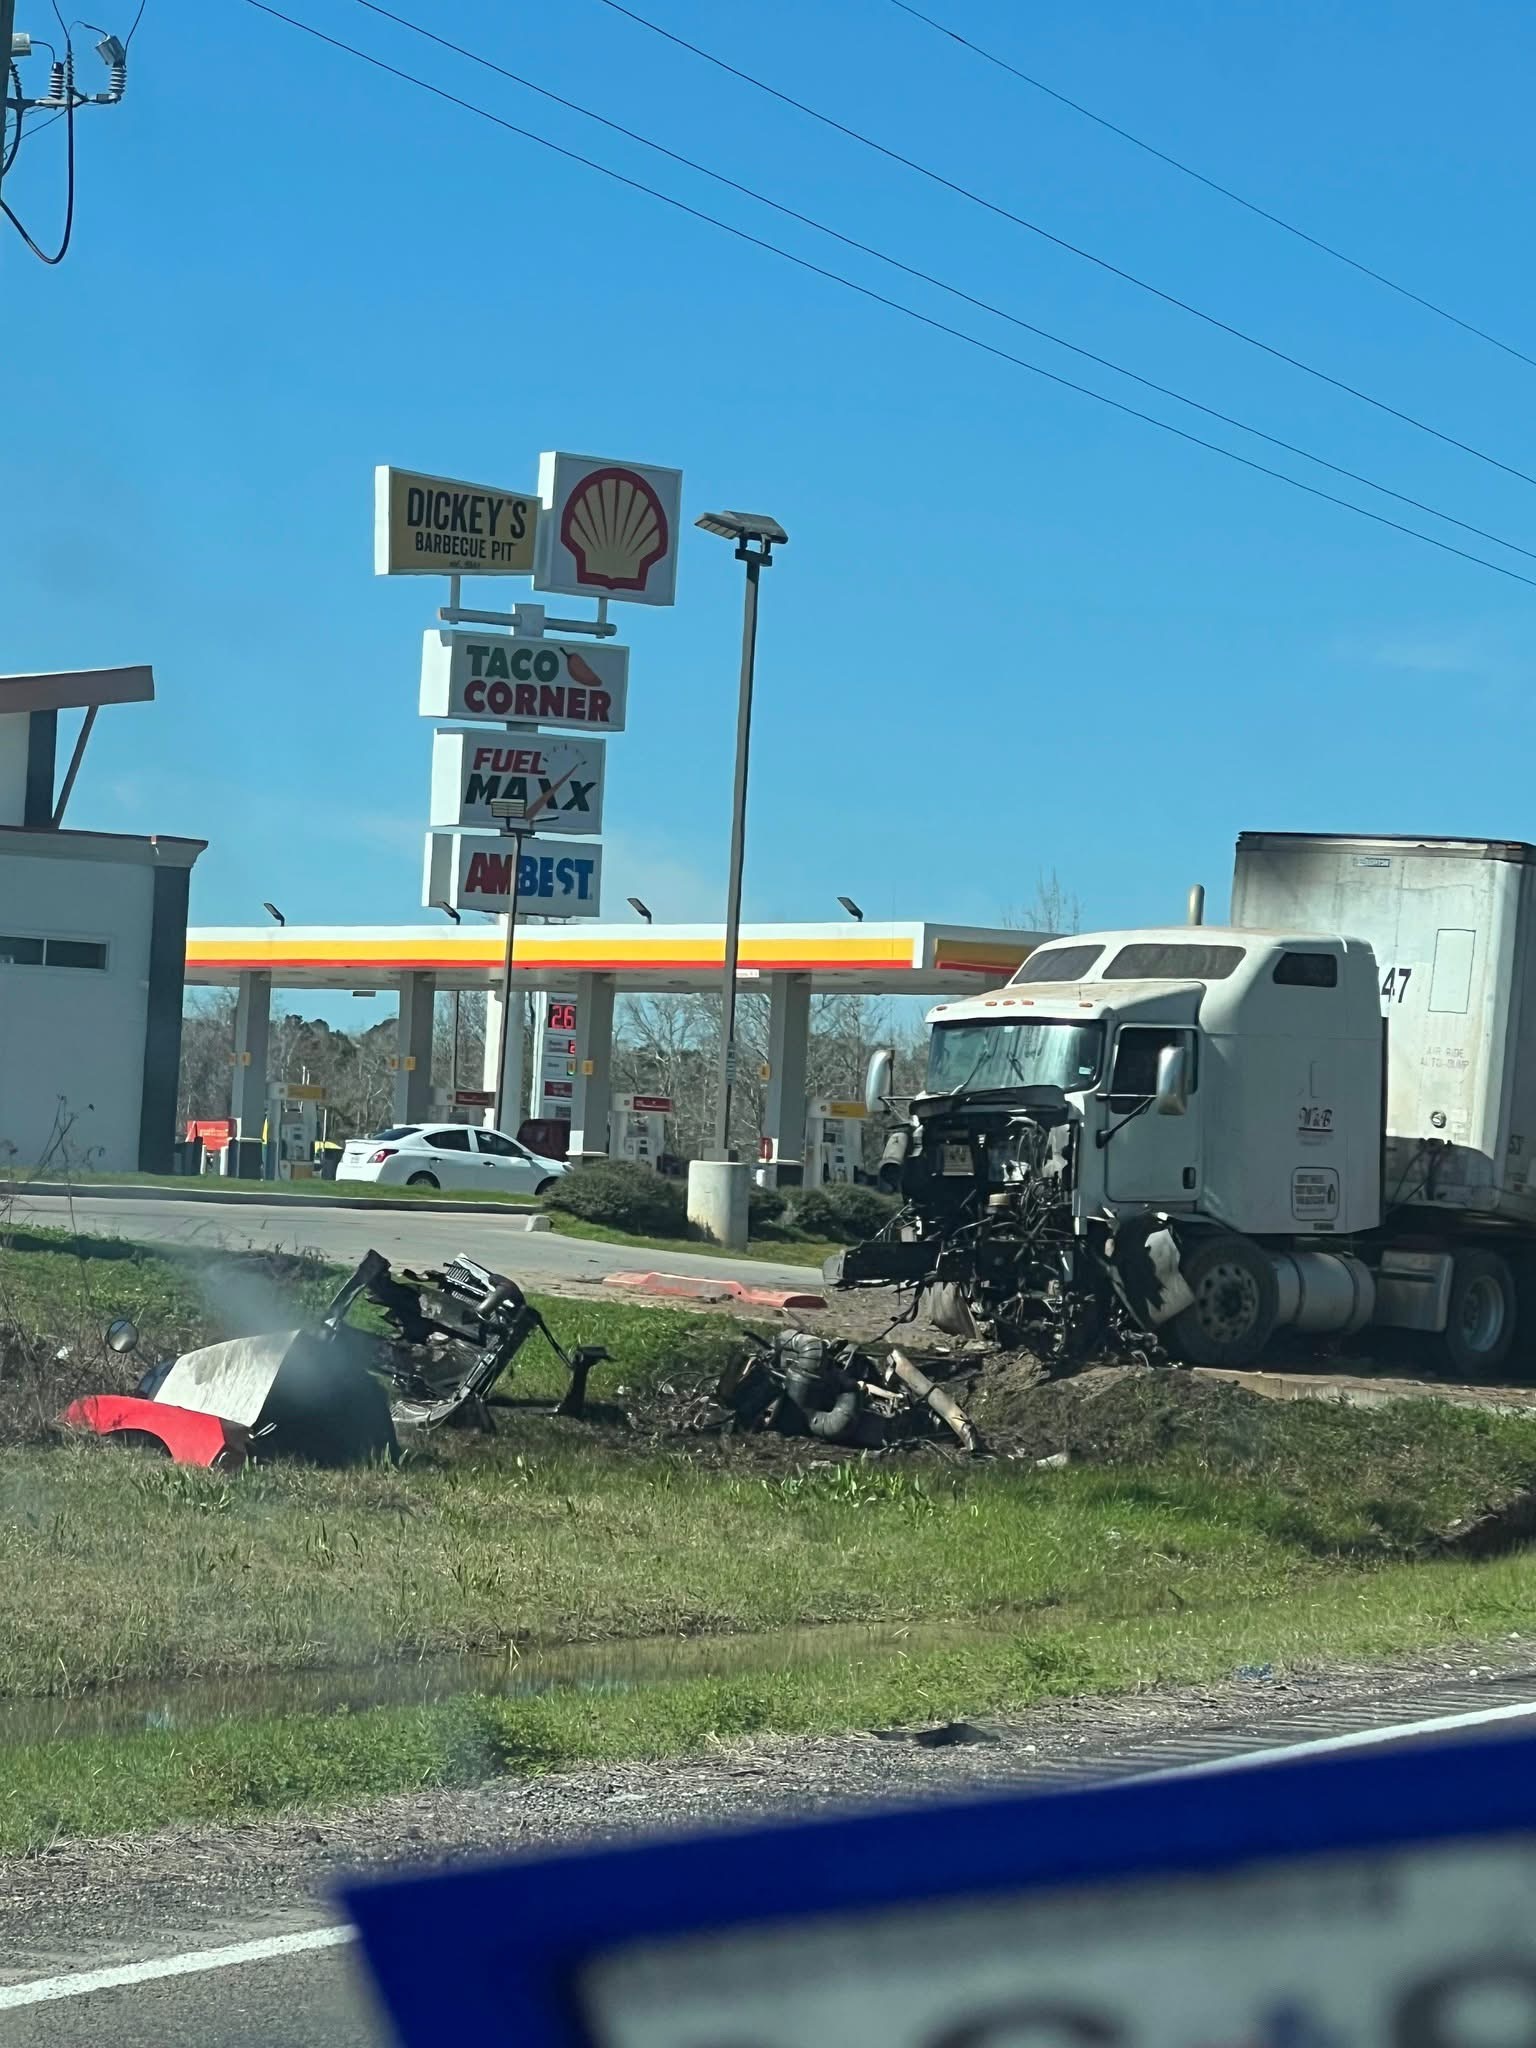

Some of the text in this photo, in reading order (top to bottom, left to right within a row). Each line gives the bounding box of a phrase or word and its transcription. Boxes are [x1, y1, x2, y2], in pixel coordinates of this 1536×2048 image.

[407, 487, 527, 540] DICKEY'S
[415, 531, 516, 562] BARBECUE PIT
[466, 645, 560, 683] TACO
[463, 679, 612, 722] CORNER
[473, 747, 546, 775] FUEL
[464, 773, 598, 812] MAXX
[464, 852, 595, 900] AMBEST
[1380, 967, 1412, 1003] 47
